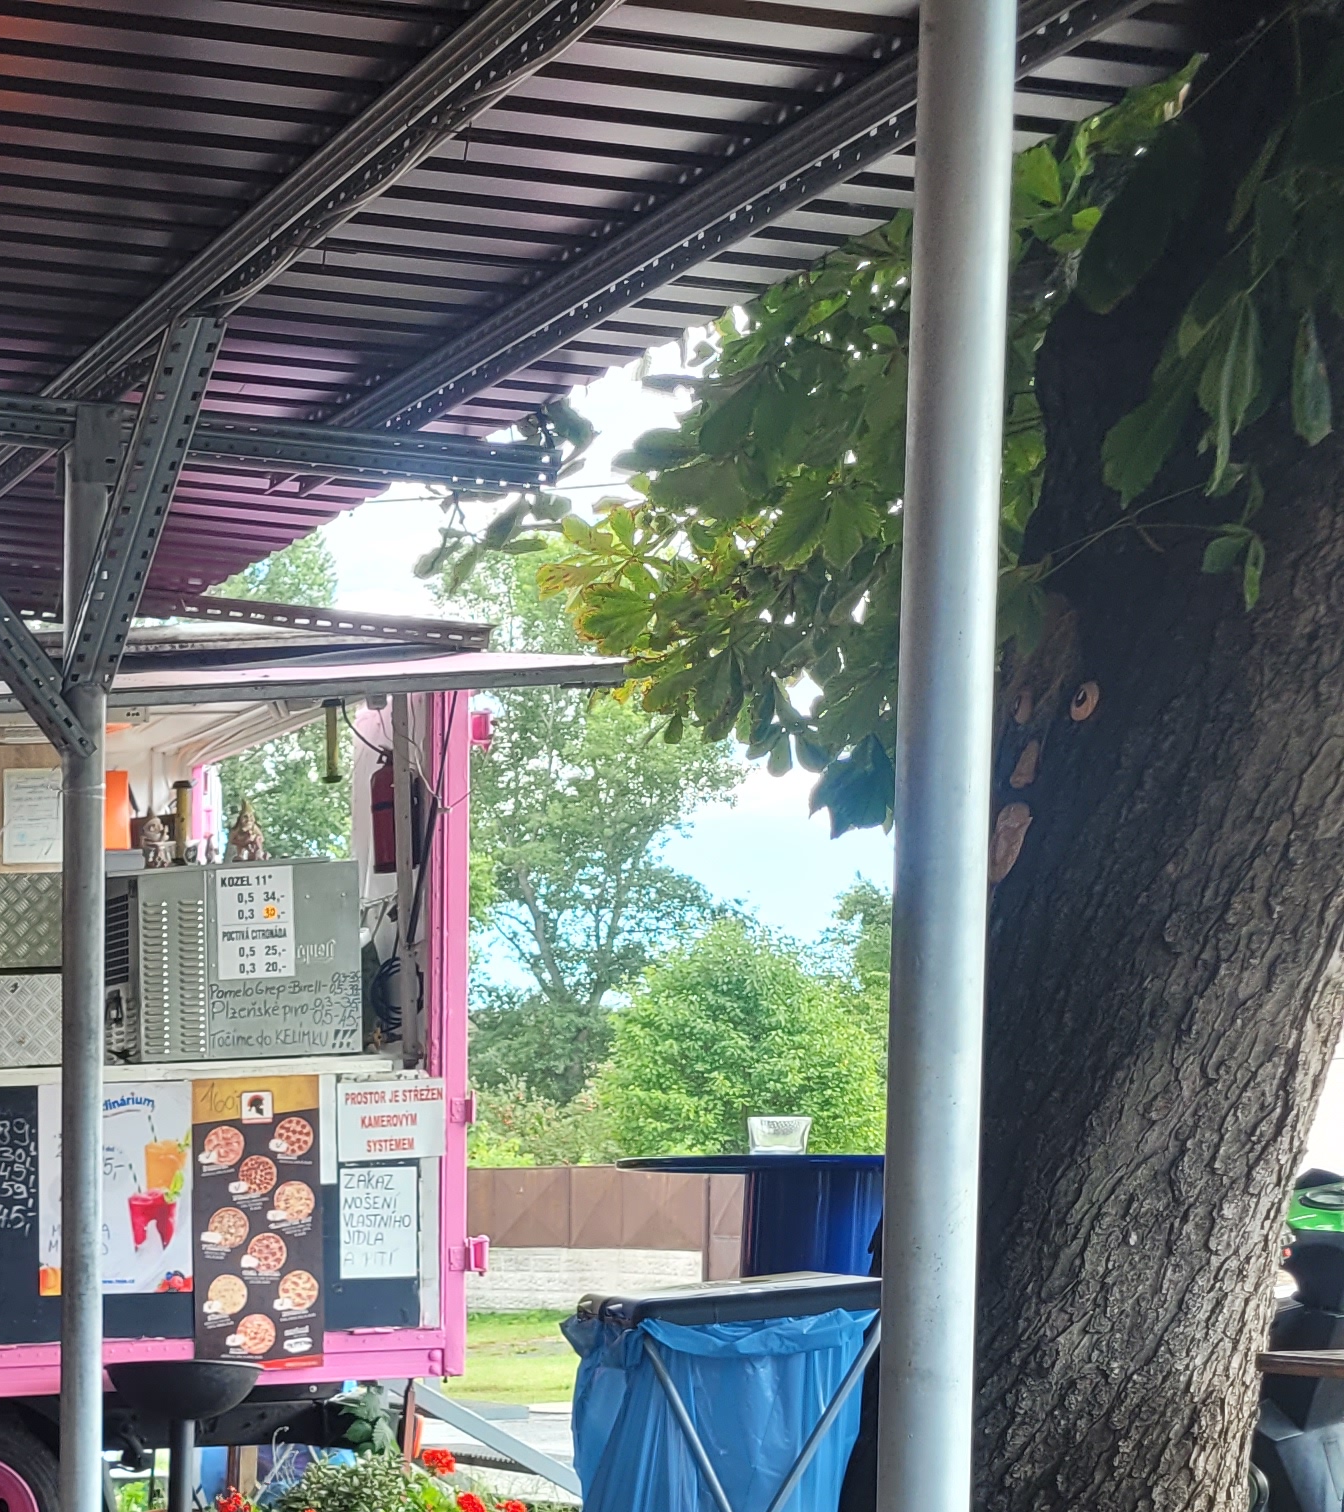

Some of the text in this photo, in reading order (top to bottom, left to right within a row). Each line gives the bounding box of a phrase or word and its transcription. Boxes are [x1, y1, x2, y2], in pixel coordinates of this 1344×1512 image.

[220, 874, 273, 888] KOZEL 11°
[237, 890, 285, 904] 0,5 34,-
[237, 906, 286, 921] 0,3 30,-
[221, 925, 288, 942] POCTIVÁ CITRONÁDA
[238, 946, 256, 959] 0,5
[264, 944, 287, 957] 25,-
[238, 961, 287, 975] 0,3 20,-
[209, 981, 254, 1000] Pomelo
[211, 999, 280, 1021] Plzeňské
[256, 1029, 272, 1048] do
[345, 1085, 444, 1105] PROSTOR JE STŘEŽEN
[361, 1110, 417, 1130] KAMEROVÝM
[366, 1135, 415, 1153] SYSTÉMEM
[343, 1170, 396, 1191] ZÁKAZ
[343, 1192, 401, 1211] NOŠENÍ
[343, 1210, 412, 1228] VLASTNÍHO
[343, 1251, 355, 1267] A
